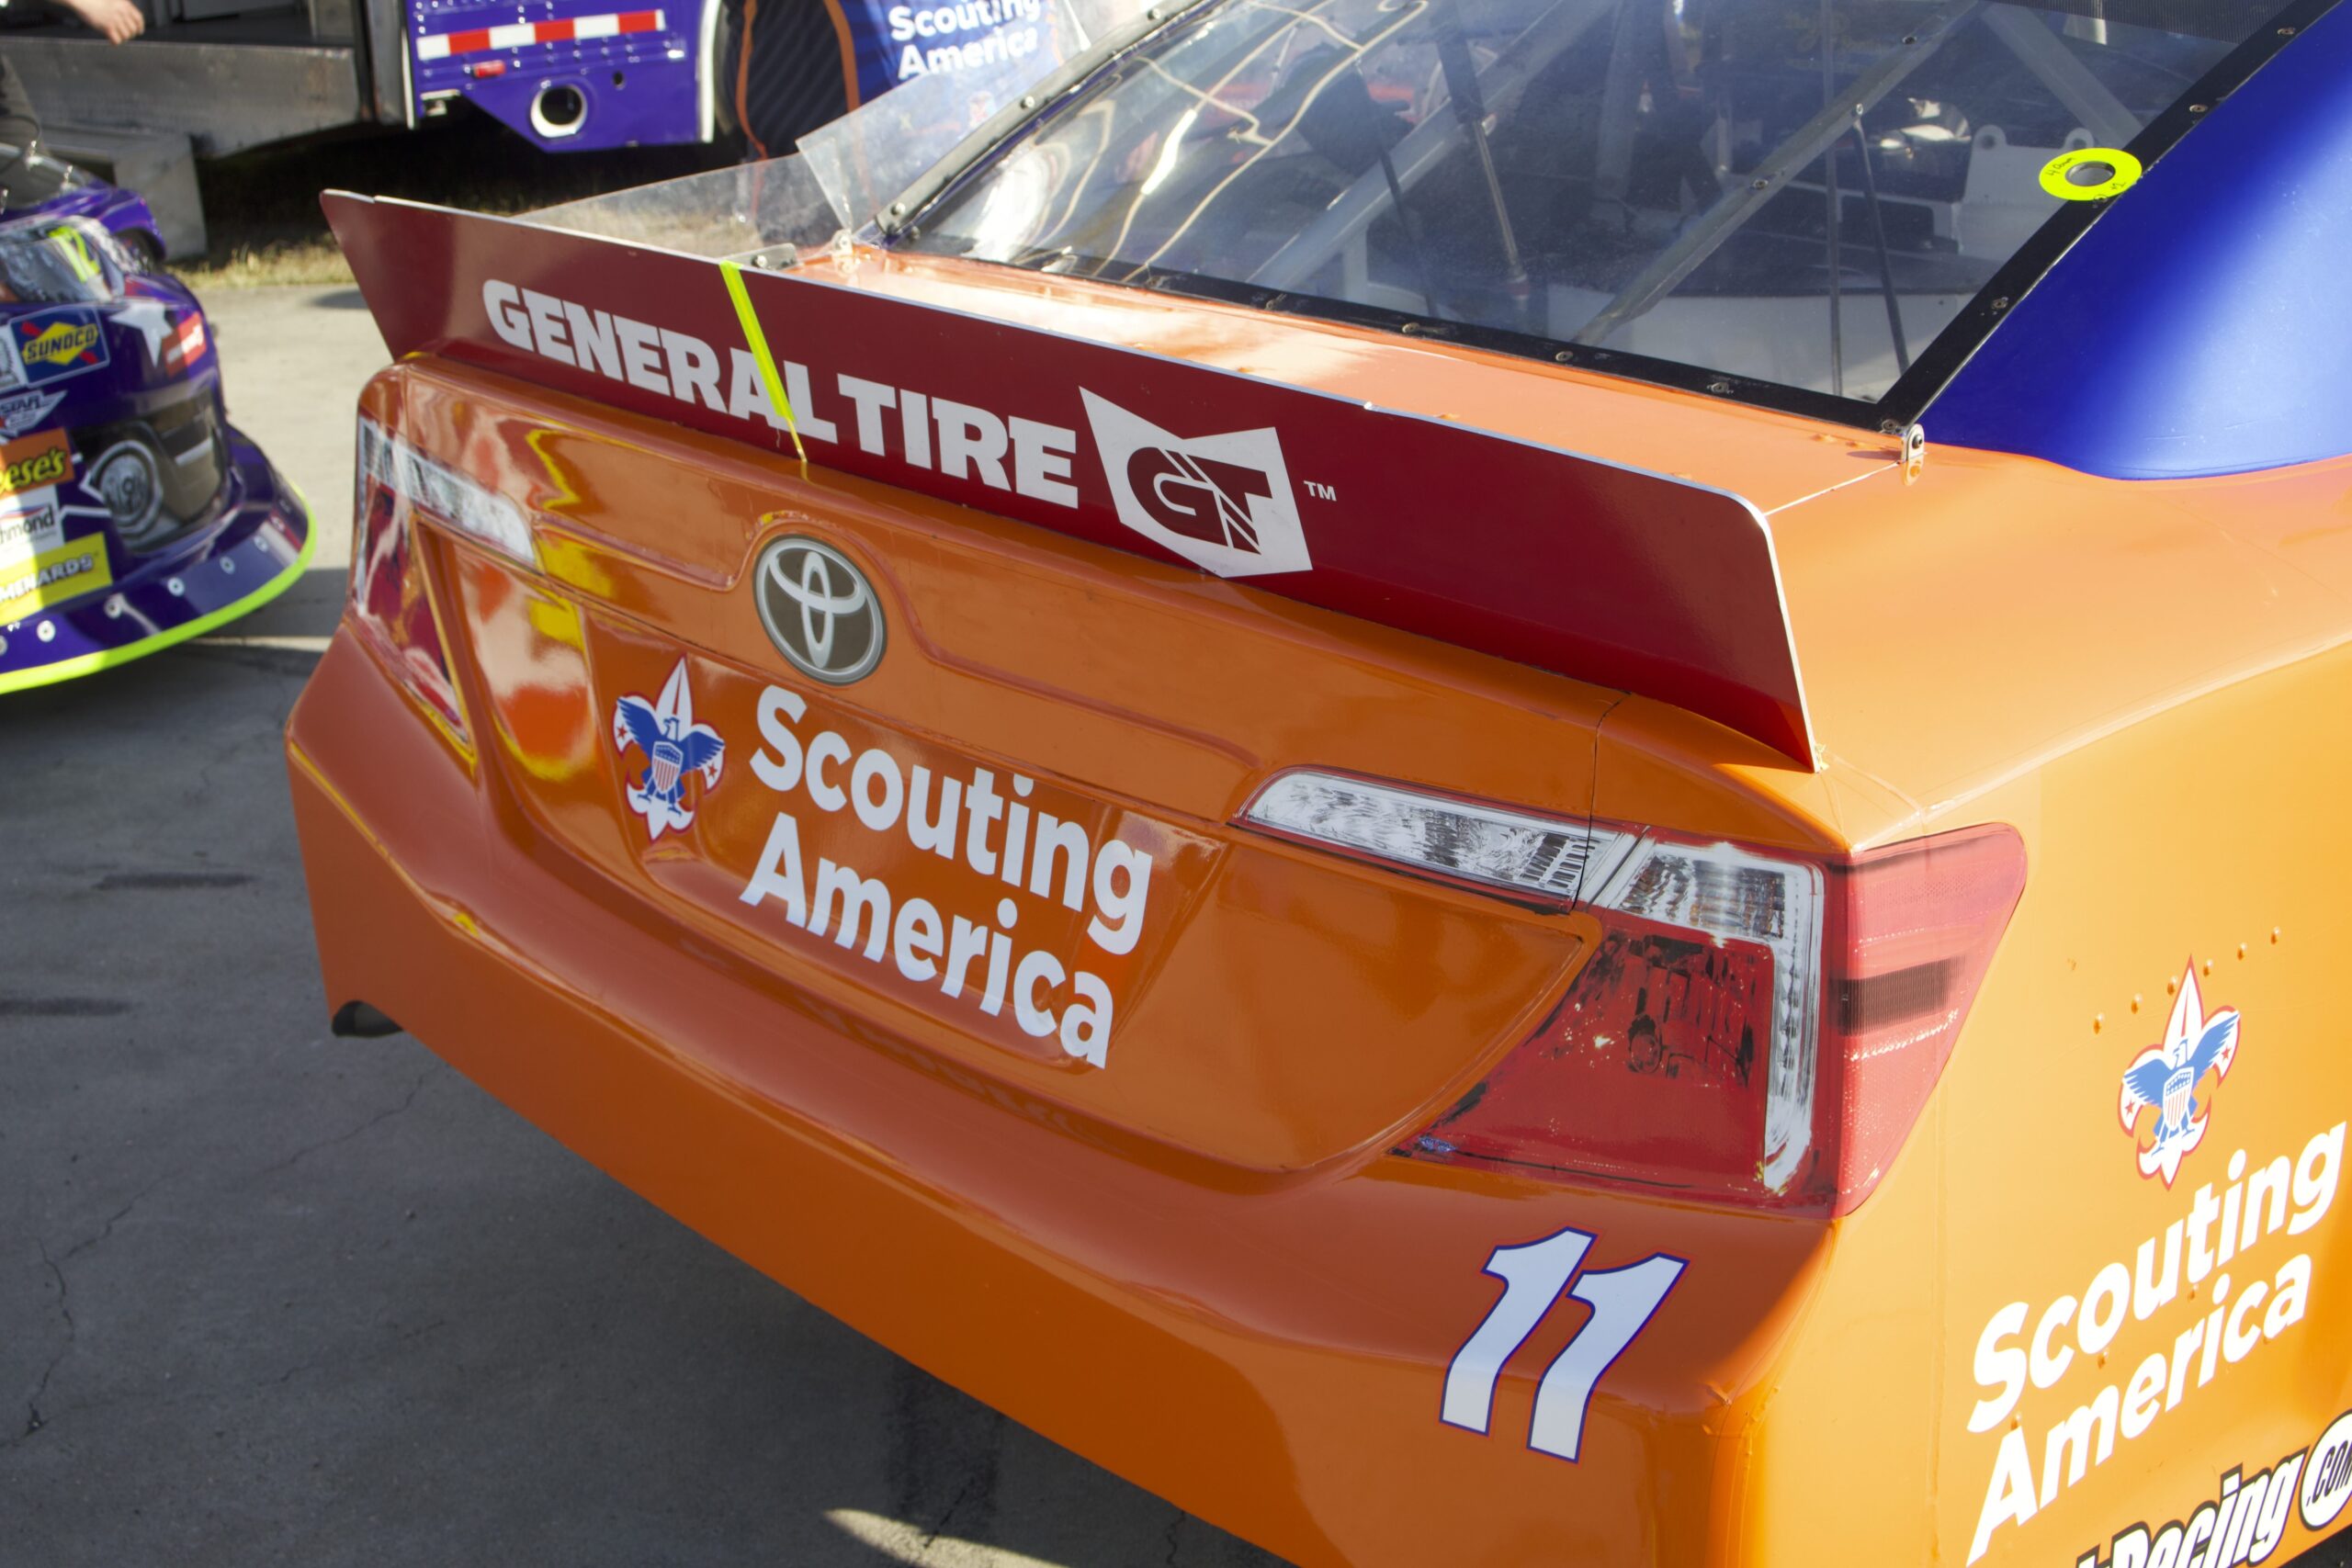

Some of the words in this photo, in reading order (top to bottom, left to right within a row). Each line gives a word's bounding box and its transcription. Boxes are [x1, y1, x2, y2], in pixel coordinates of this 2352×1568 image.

[888, 0, 1040, 40] Scouting
[899, 27, 1038, 79] America
[25, 326, 96, 362] SUNOCO
[481, 278, 839, 446] GENERAL
[837, 373, 1080, 510] TIRE
[1304, 479, 1337, 502] TM
[0, 553, 94, 604] MENARDS
[749, 683, 1153, 955] Scouting
[739, 812, 1114, 1069] America
[1439, 1225, 1691, 1464] 11
[1966, 1122, 2347, 1434] Scouting
[1965, 1253, 2312, 1568] America
